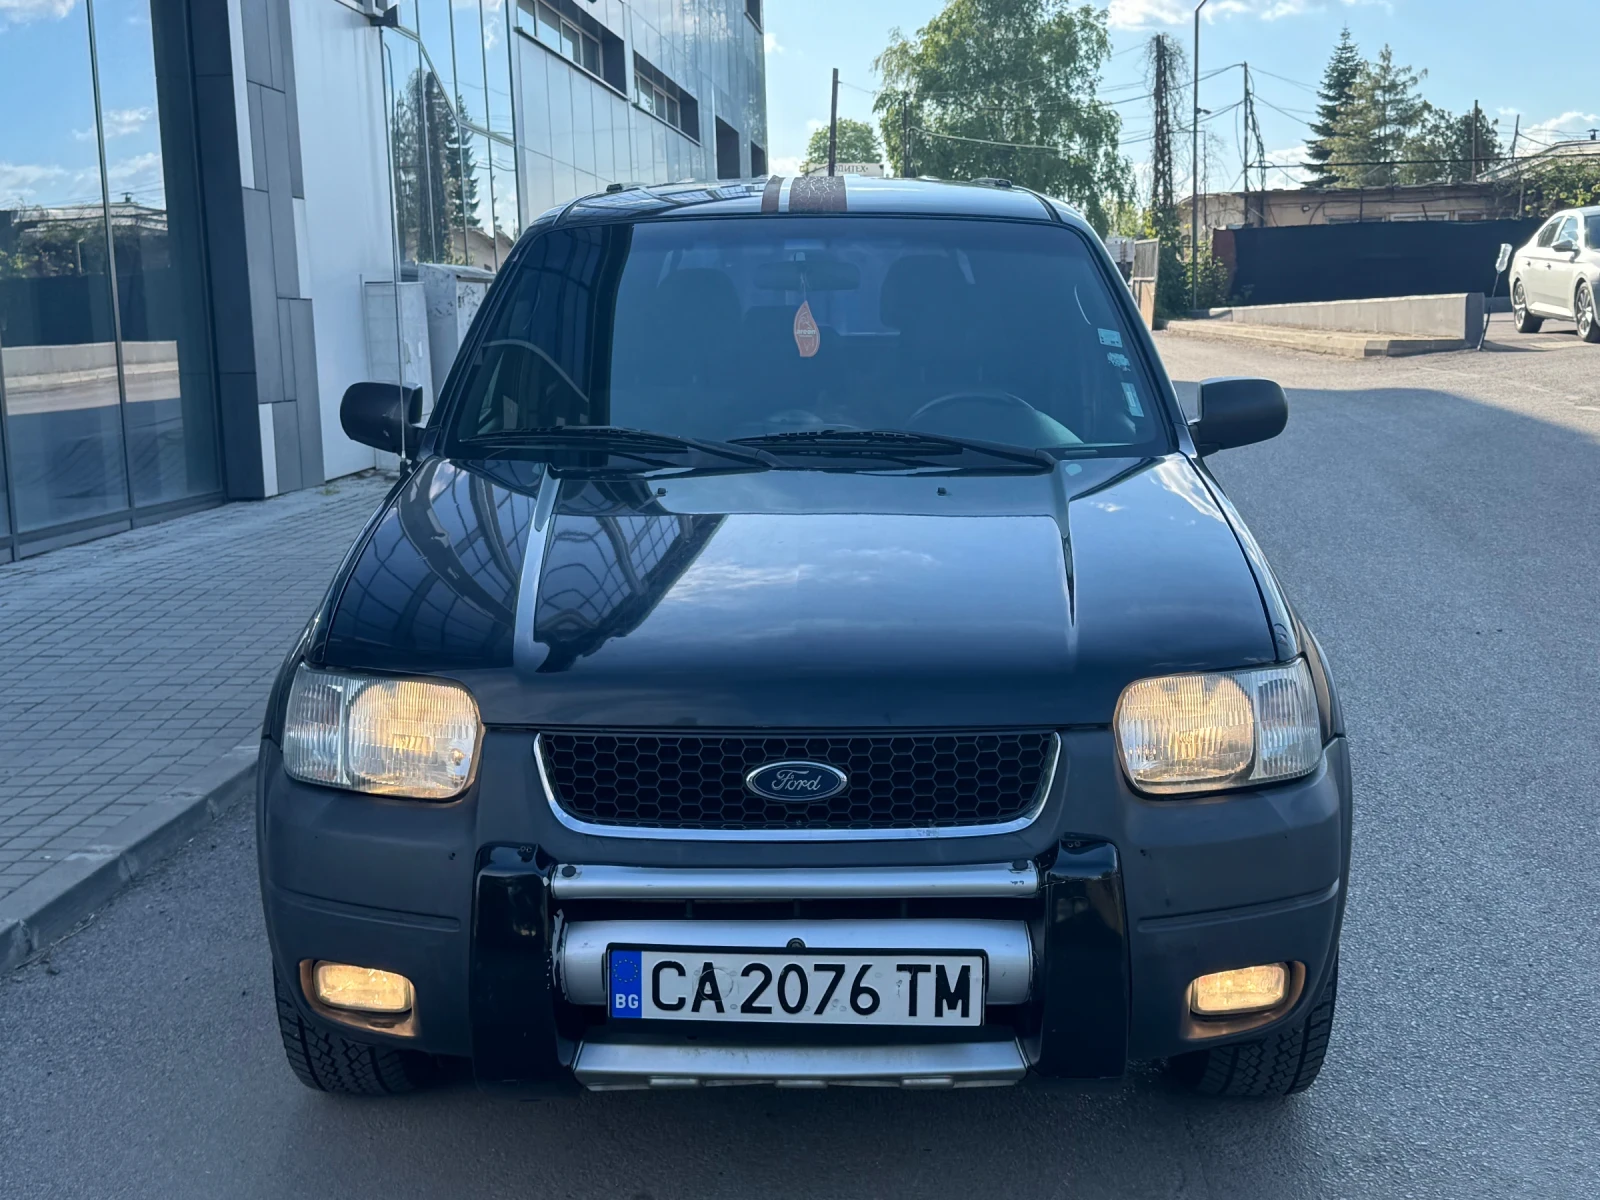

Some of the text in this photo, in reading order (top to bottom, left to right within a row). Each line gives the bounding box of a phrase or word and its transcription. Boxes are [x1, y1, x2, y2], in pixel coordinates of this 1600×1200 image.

[771, 769, 822, 791] Ford
[651, 960, 971, 1018] CA 2076 TM
[615, 993, 639, 1009] BG
